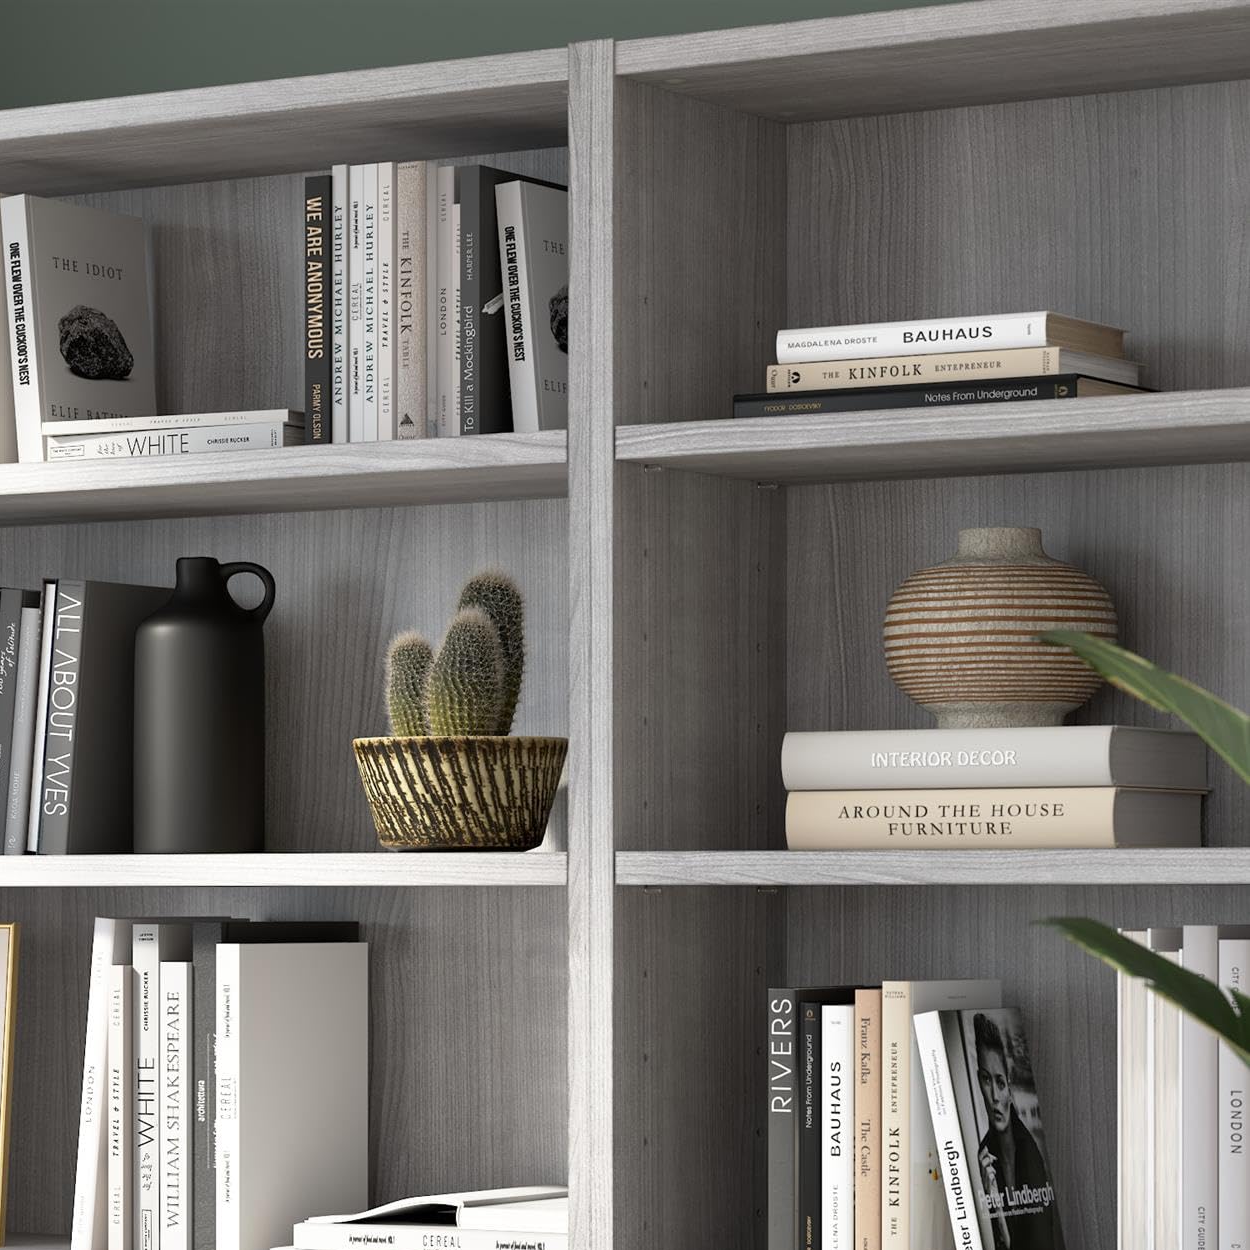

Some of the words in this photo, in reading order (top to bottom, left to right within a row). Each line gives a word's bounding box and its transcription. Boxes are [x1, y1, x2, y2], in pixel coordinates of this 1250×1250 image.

[306, 196, 322, 222] WE
[306, 226, 323, 256] ARE
[366, 204, 374, 261] HURLEY
[505, 225, 515, 242] ONE
[10, 242, 20, 258] ONE
[506, 243, 517, 264] FLEW
[543, 240, 565, 255] THE
[11, 258, 23, 282] FLEW
[52, 257, 78, 272] THE
[86, 262, 123, 280] IDIOT
[507, 264, 519, 286] OVER
[13, 282, 24, 305] OVER
[366, 268, 374, 333] MICHAEL
[400, 257, 412, 334] KINFOLK
[510, 287, 520, 302] THE
[14, 305, 25, 323] THE
[307, 261, 324, 359] ANONYMOUS
[511, 302, 524, 342] CUCKOO'S
[15, 323, 29, 368] CUCKOO'S
[464, 305, 476, 380] Mockingbird
[514, 340, 526, 362] NEST
[787, 339, 842, 349] MAGDALENA
[845, 336, 878, 344] DROSTE
[903, 326, 993, 344] BAUHAUS
[18, 366, 30, 385] NEST
[335, 343, 343, 405] ANDREW
[366, 341, 374, 403] ANDREW
[822, 371, 840, 379] THE
[849, 364, 922, 380] KINFOLK
[934, 361, 1002, 372] ENTEPRENEUR
[312, 384, 321, 412] PARMY
[464, 395, 474, 413] Kill
[924, 392, 951, 403] Notes
[952, 391, 976, 401] From
[977, 387, 1038, 402] Underground
[313, 413, 321, 439] OLSON
[464, 418, 474, 432] To
[126, 433, 189, 456] WHITE
[56, 592, 82, 640] ALL
[0, 650, 7, 677] years
[5, 657, 15, 667] of
[49, 648, 78, 742] ABOUT
[871, 751, 952, 768] INTERIOR
[958, 750, 1017, 767] DECOR
[43, 753, 71, 816] YVES
[838, 804, 928, 819] AROUND
[938, 804, 981, 818] THE
[990, 803, 1065, 818] HOUSE
[888, 821, 1013, 836] FURNITURE
[861, 1018, 871, 1050] Franz
[166, 991, 180, 1131] SHAKESPEARE
[771, 999, 792, 1113] RIVERS
[805, 1034, 815, 1085] Underground
[861, 1052, 871, 1085] Kafka
[137, 1057, 155, 1148] WHITE
[805, 1086, 813, 1105] From
[830, 1061, 841, 1157] BAUHAUS
[861, 1119, 871, 1139] The
[1230, 1090, 1242, 1154] LONDON
[861, 1145, 871, 1177] Castle
[889, 1127, 900, 1207] KINFOLK
[166, 1137, 180, 1228] WILLIAM
[944, 1140, 967, 1220] Lindbergh
[978, 1189, 1004, 1209] Peter
[1005, 1181, 1055, 1207] Lindbergh
[422, 1234, 461, 1249] CEREAL
